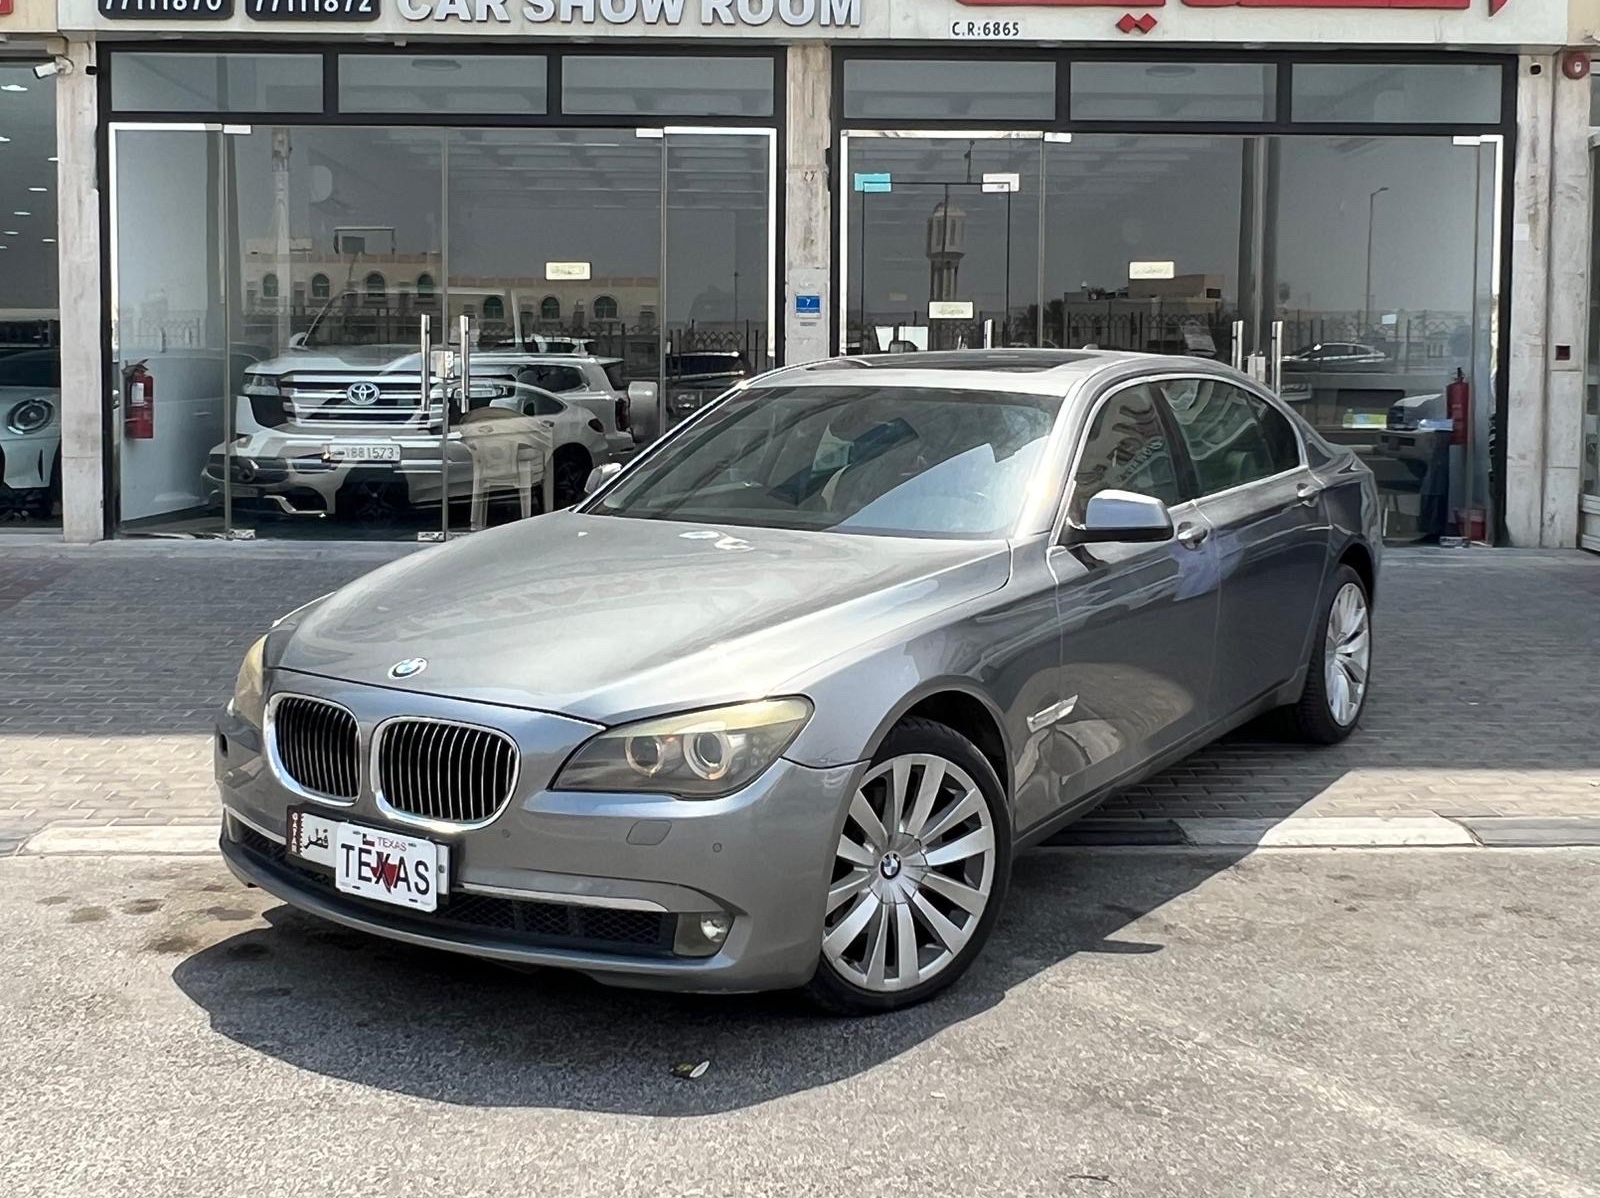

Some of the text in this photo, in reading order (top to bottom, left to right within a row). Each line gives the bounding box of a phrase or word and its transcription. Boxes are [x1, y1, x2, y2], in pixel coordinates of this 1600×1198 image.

[396, 0, 861, 26] CAR SHOW ROOM
[951, 21, 1020, 37] C.R:6865
[303, 828, 329, 850] قطر
[377, 836, 407, 852] TEXAS
[341, 842, 430, 896] TEXAS
